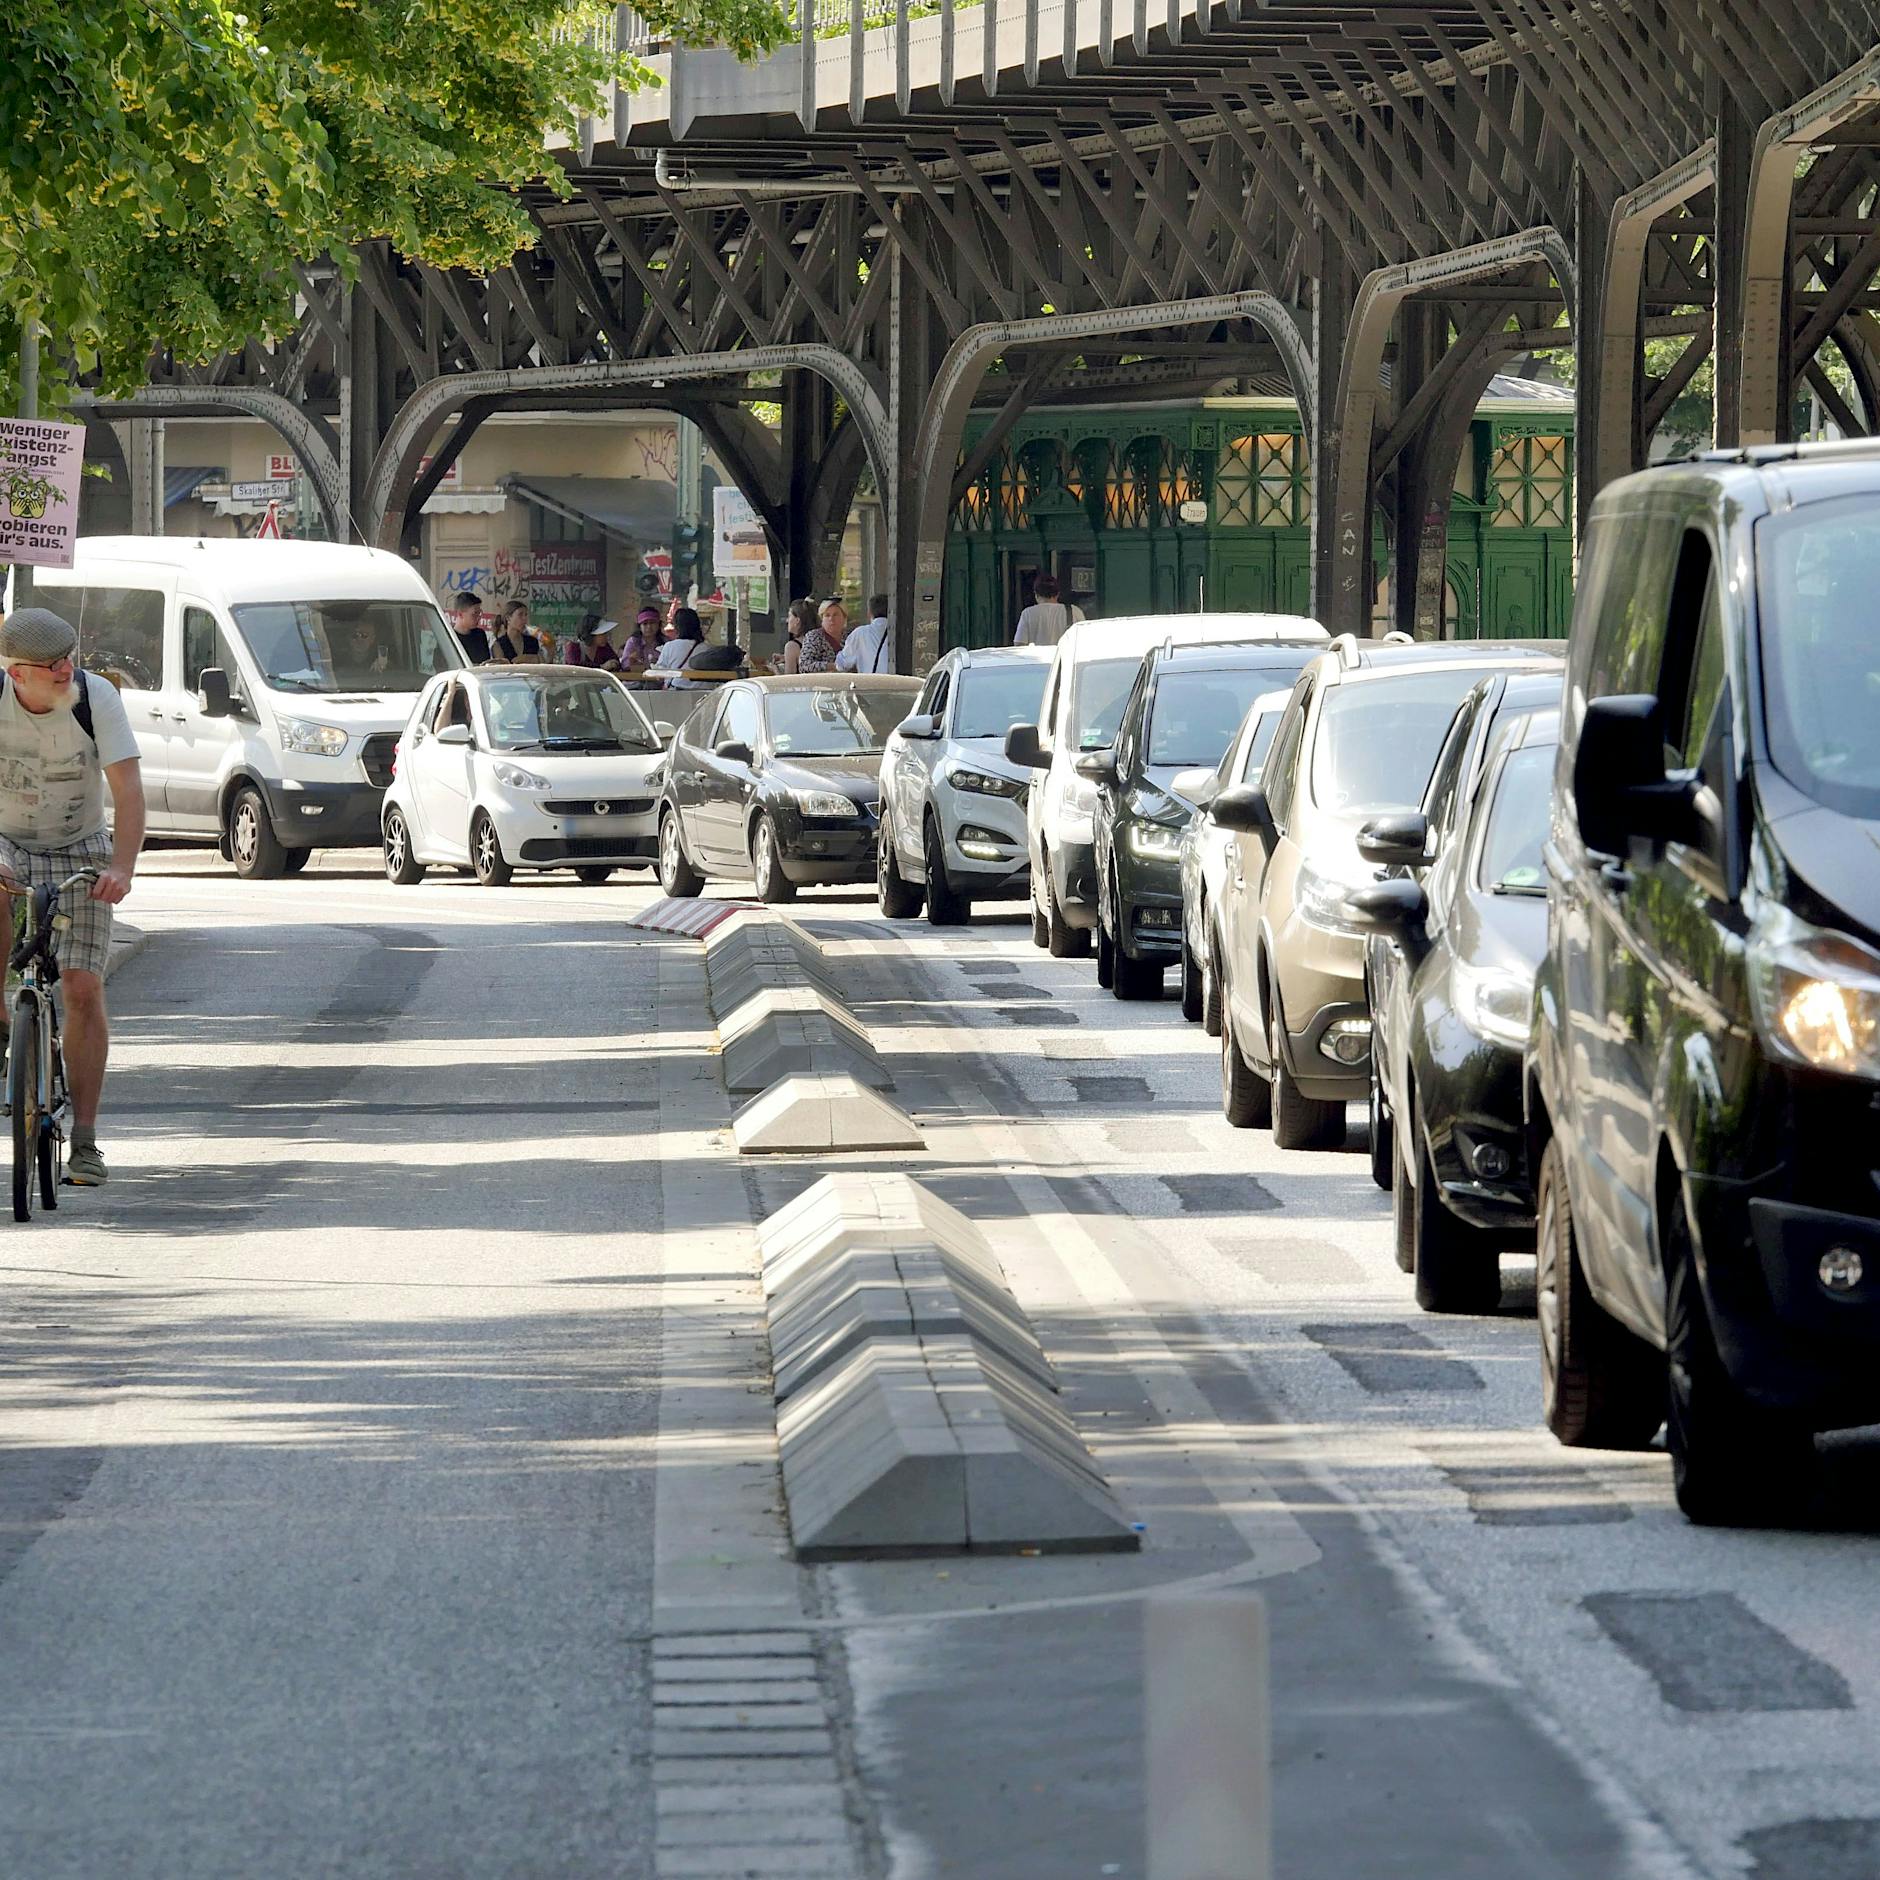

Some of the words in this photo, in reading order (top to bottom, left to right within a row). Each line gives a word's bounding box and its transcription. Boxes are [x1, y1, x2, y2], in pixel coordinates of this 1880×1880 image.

[0, 422, 70, 440] Weniger
[7, 452, 57, 467] angst
[271, 457, 296, 470] BL
[0, 518, 67, 536] obieren
[29, 537, 63, 549] aus.
